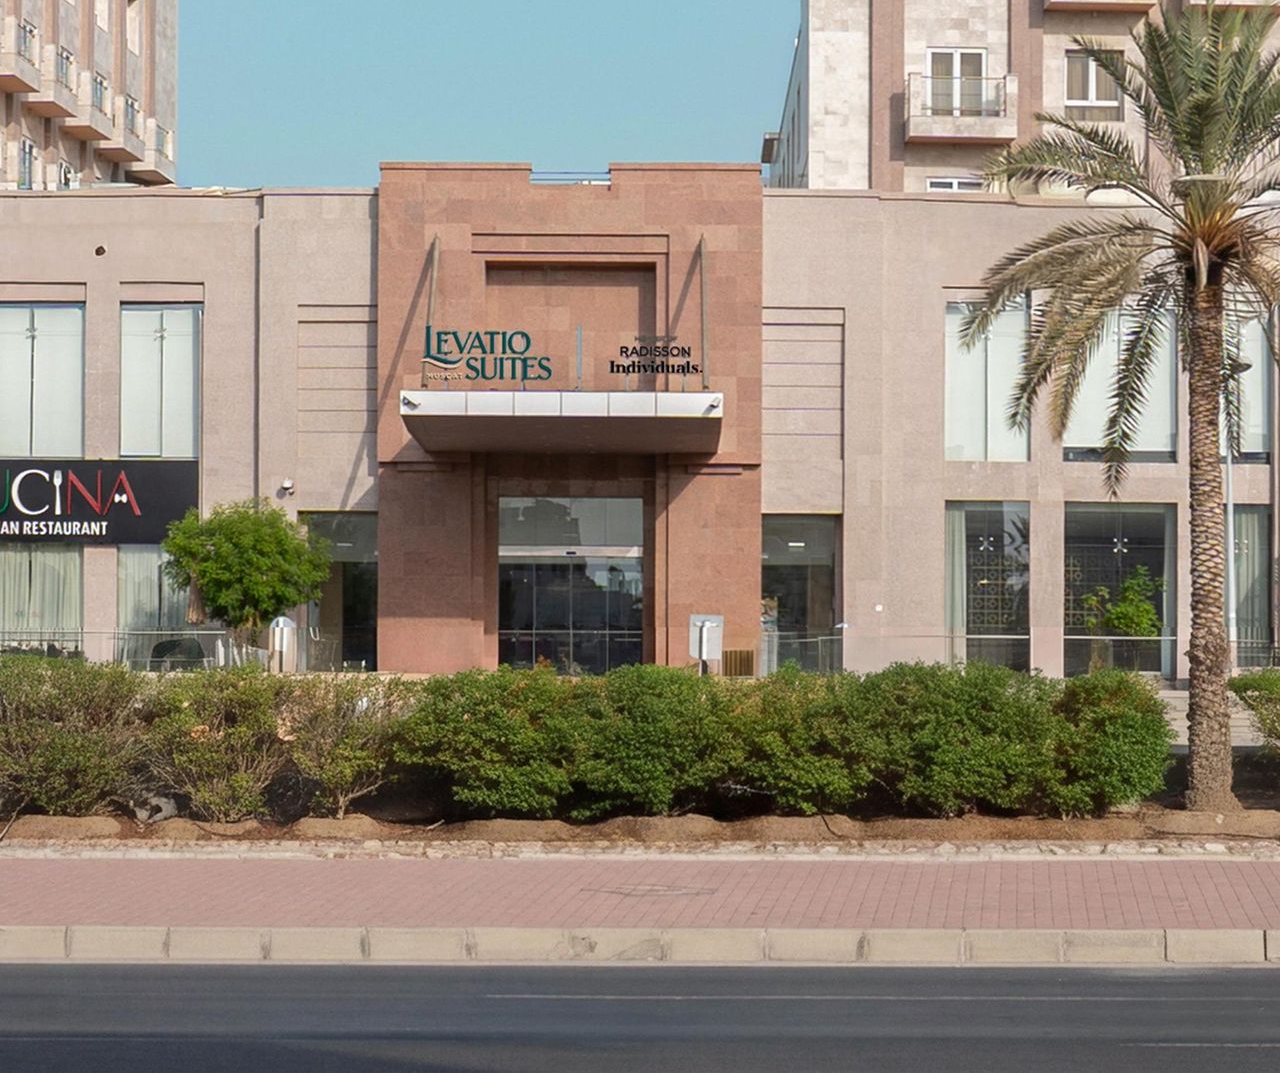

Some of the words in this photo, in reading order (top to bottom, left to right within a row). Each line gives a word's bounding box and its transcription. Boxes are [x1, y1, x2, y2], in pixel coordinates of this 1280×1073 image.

[423, 325, 531, 356] LEVATIO
[619, 346, 692, 358] RADISSON
[465, 356, 553, 380] SUITES
[609, 360, 703, 374] Individuals.
[22, 521, 108, 536] RESTAURANT
